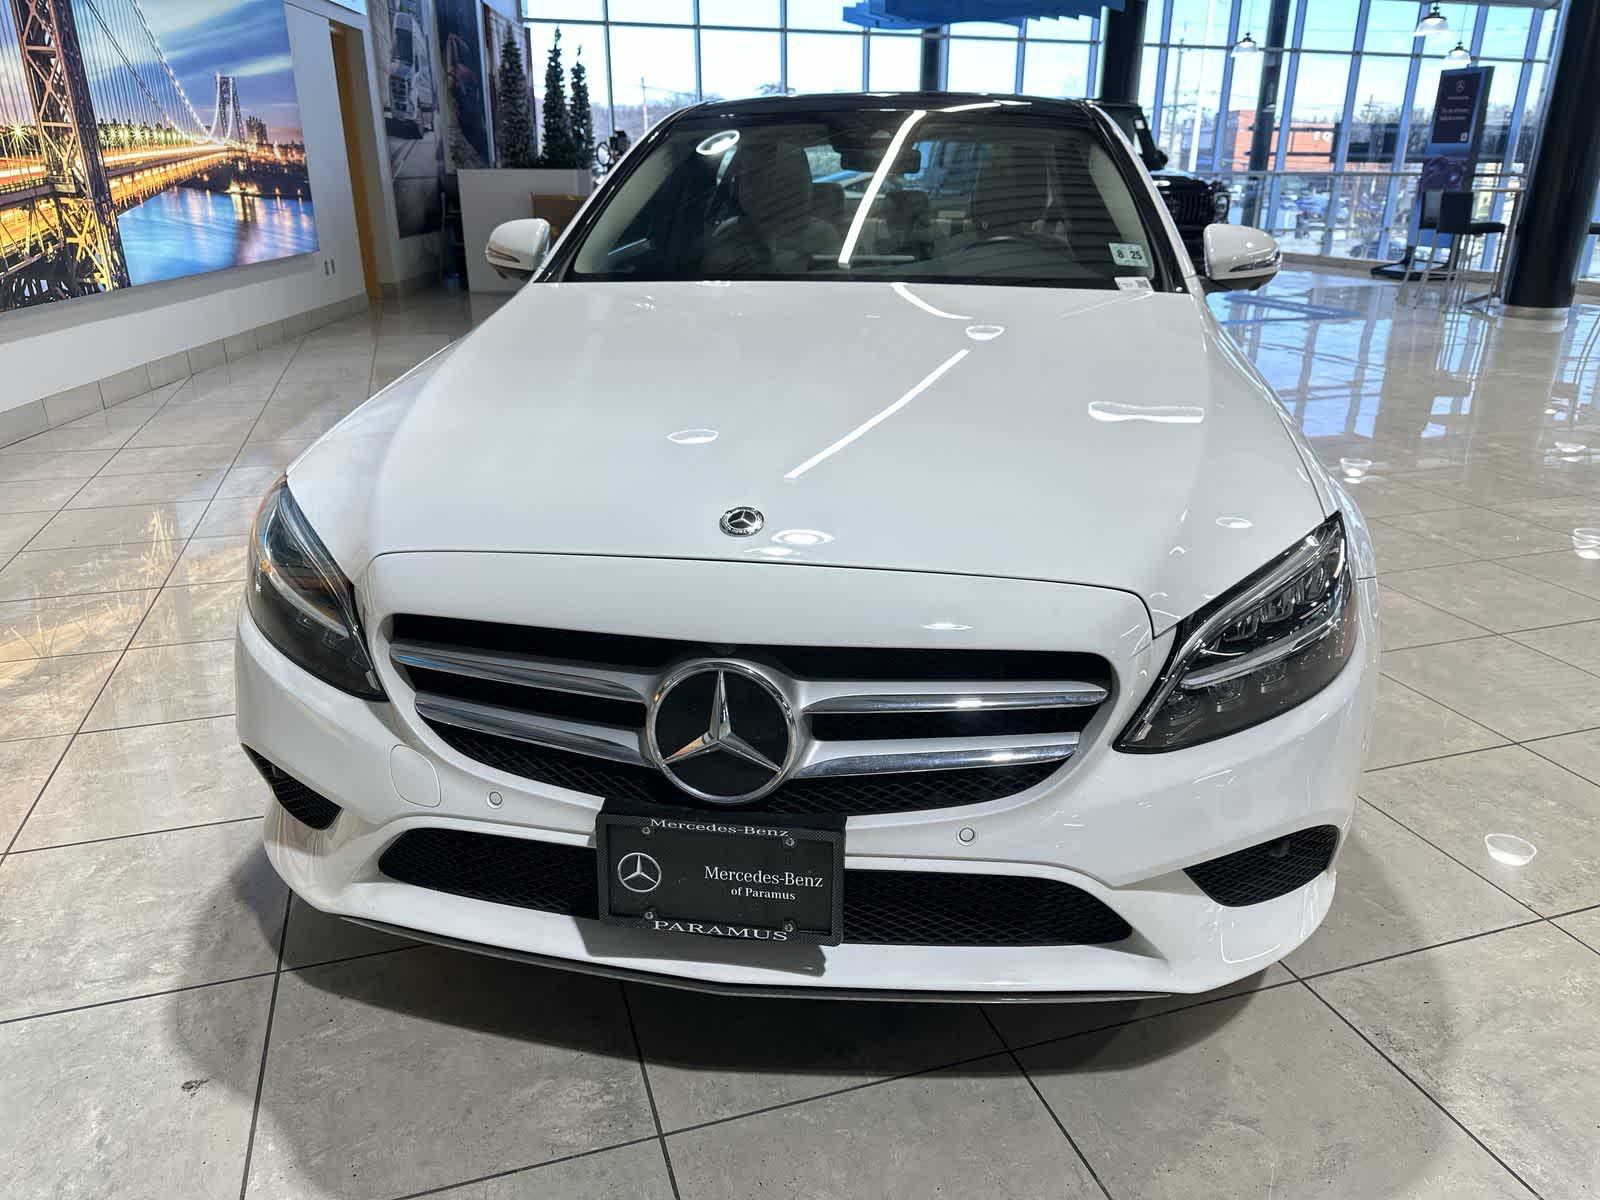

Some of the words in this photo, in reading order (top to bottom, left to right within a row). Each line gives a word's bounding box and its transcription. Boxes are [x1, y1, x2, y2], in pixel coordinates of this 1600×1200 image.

[1129, 250, 1142, 260] 25
[650, 818, 789, 837] Mercedes-Benz
[704, 865, 823, 888] Mercedes-Benz
[730, 886, 742, 896] of
[745, 887, 796, 901] Paramus
[653, 920, 788, 941] PARAMUS
